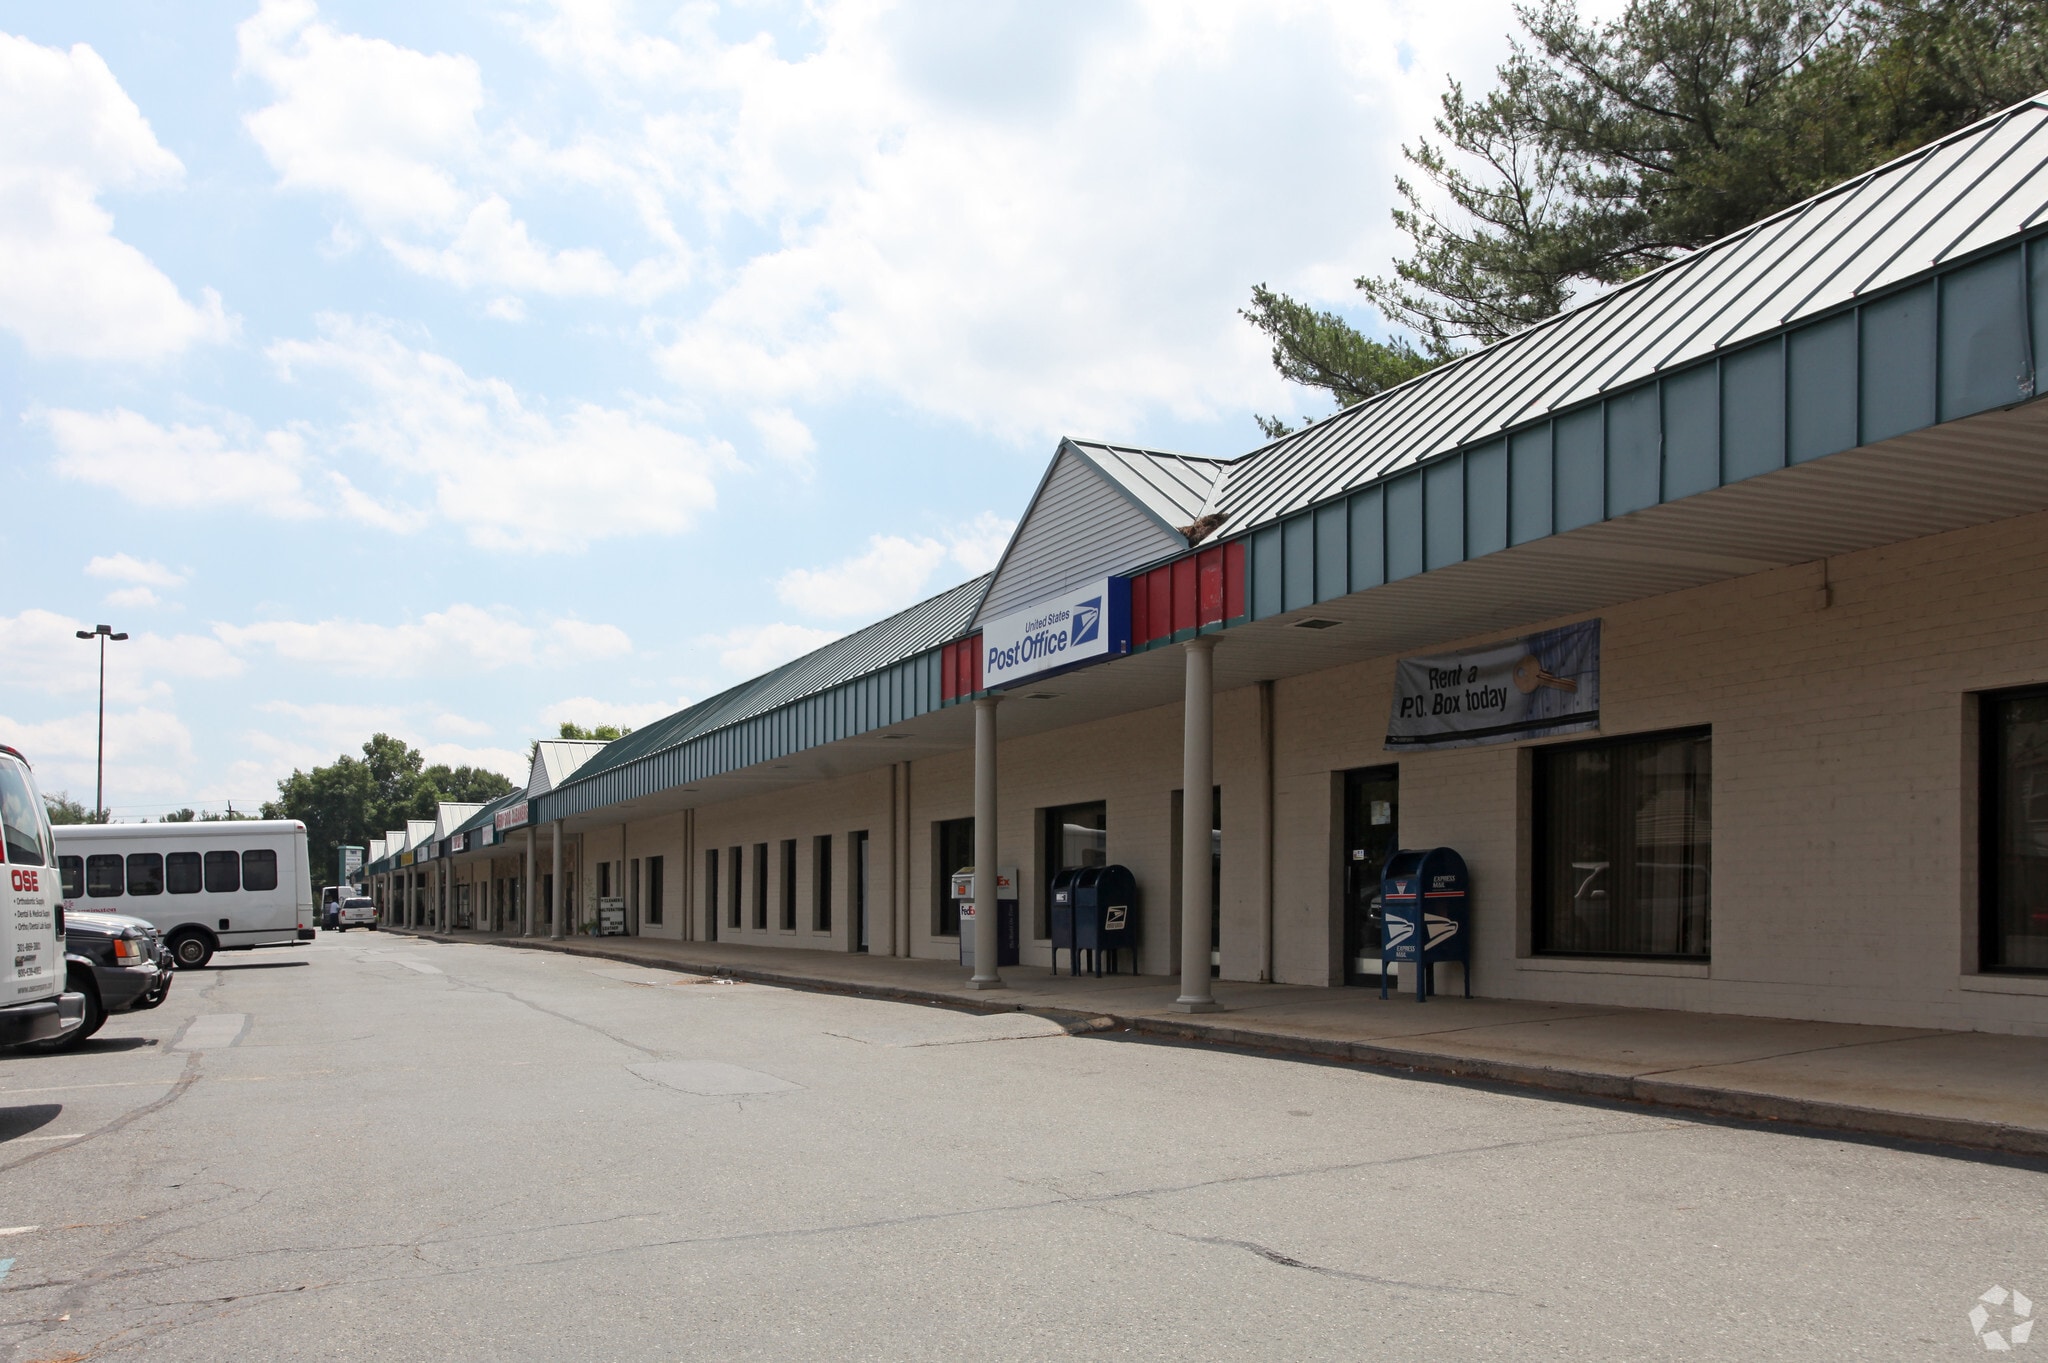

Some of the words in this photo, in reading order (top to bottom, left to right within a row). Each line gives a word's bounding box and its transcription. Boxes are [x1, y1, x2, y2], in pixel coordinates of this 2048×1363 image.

[1025, 616, 1047, 633] United
[1048, 610, 1070, 625] States
[988, 641, 1020, 674] Post
[1021, 629, 1068, 662] Office
[1428, 664, 1462, 690] Rent
[1467, 665, 1478, 684] a
[1400, 694, 1427, 718] P.O.
[1431, 693, 1460, 716] Box
[1465, 685, 1507, 712] today
[11, 869, 39, 892] OSE
